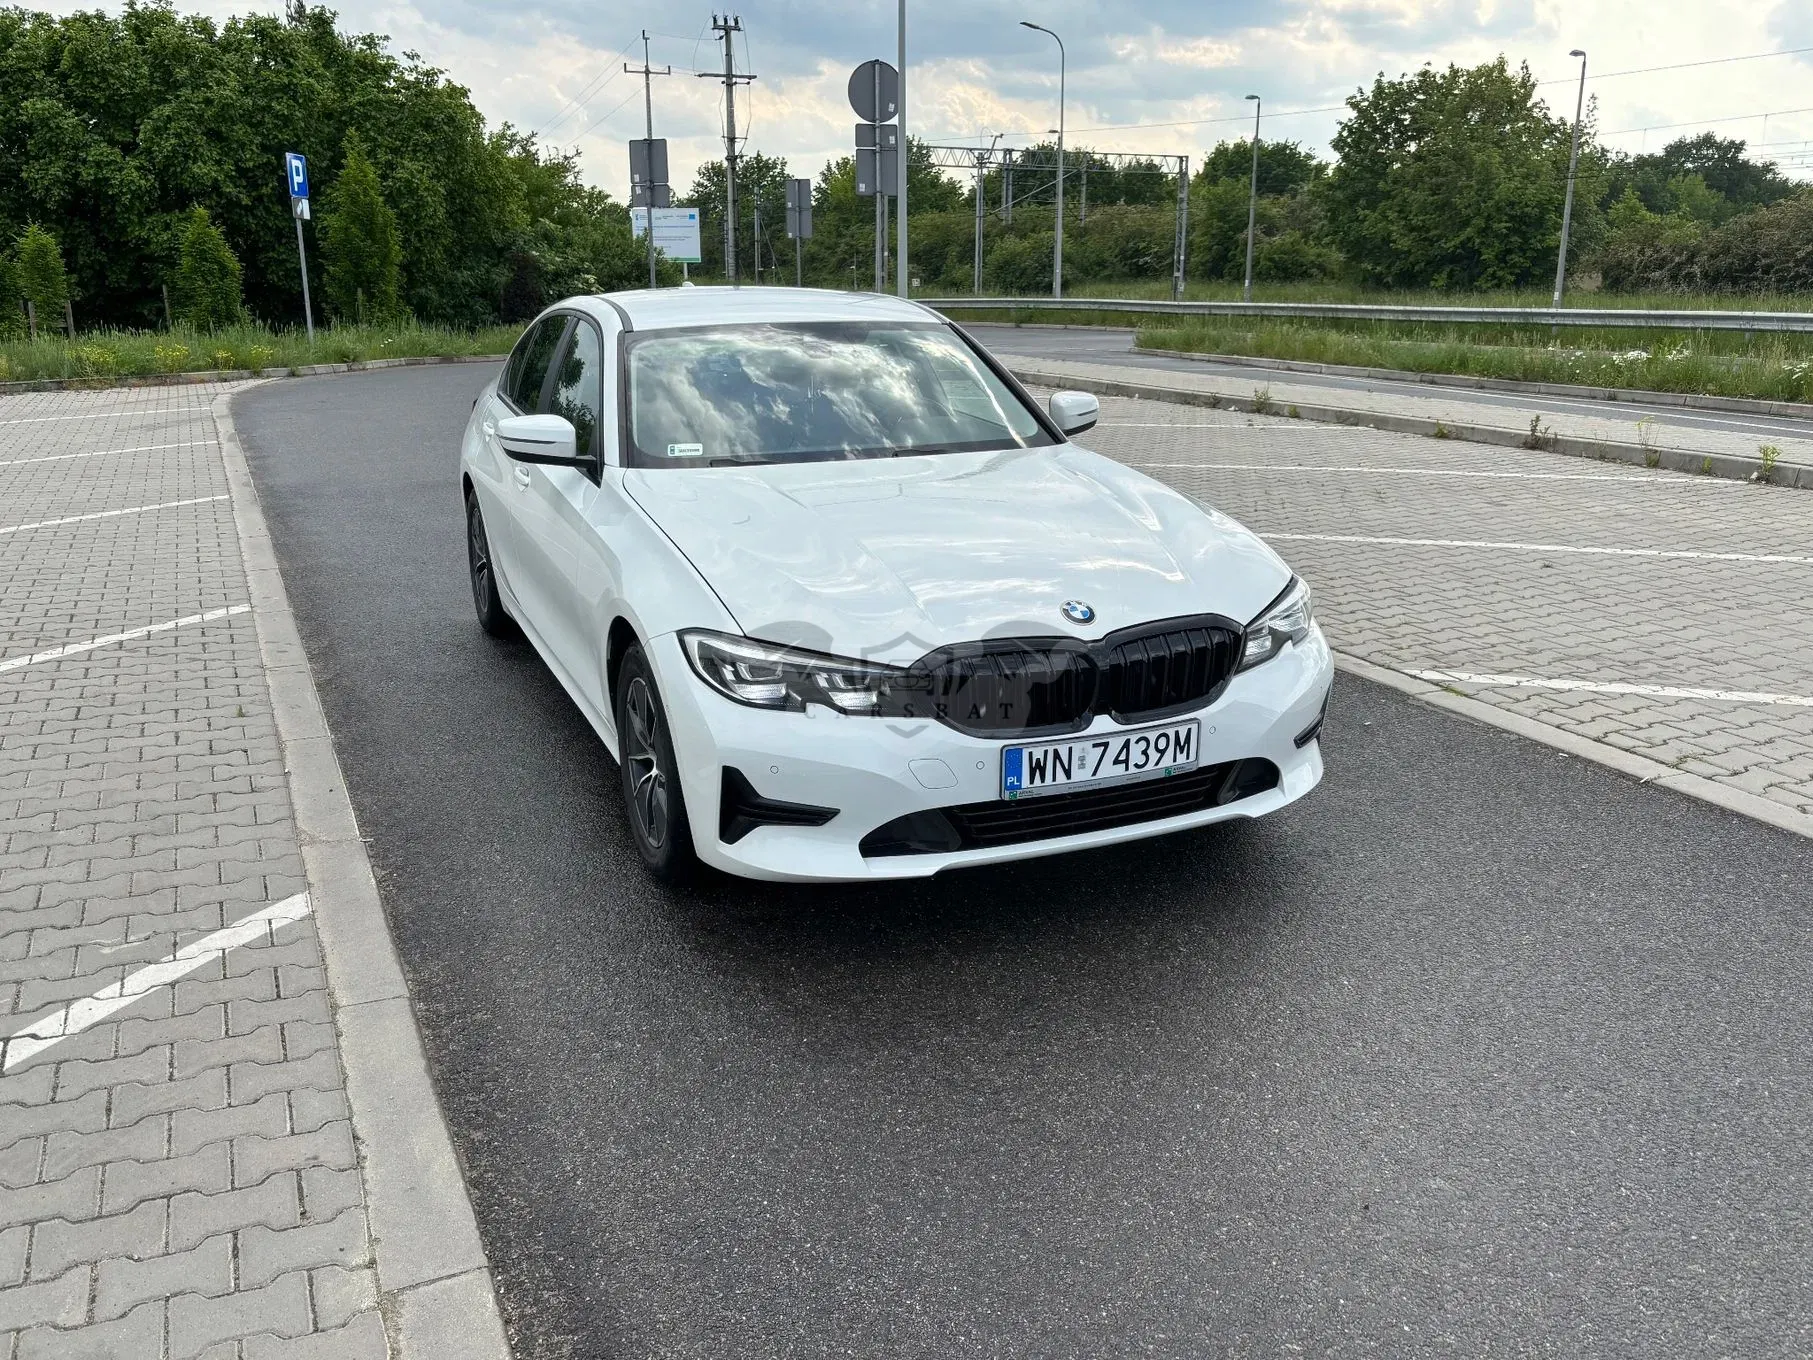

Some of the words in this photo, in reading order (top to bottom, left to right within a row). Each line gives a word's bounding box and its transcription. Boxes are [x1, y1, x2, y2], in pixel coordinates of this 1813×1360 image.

[291, 159, 304, 191] P
[1028, 746, 1073, 785] WN
[1091, 728, 1192, 777] 7439M
[1007, 776, 1020, 786] PL
